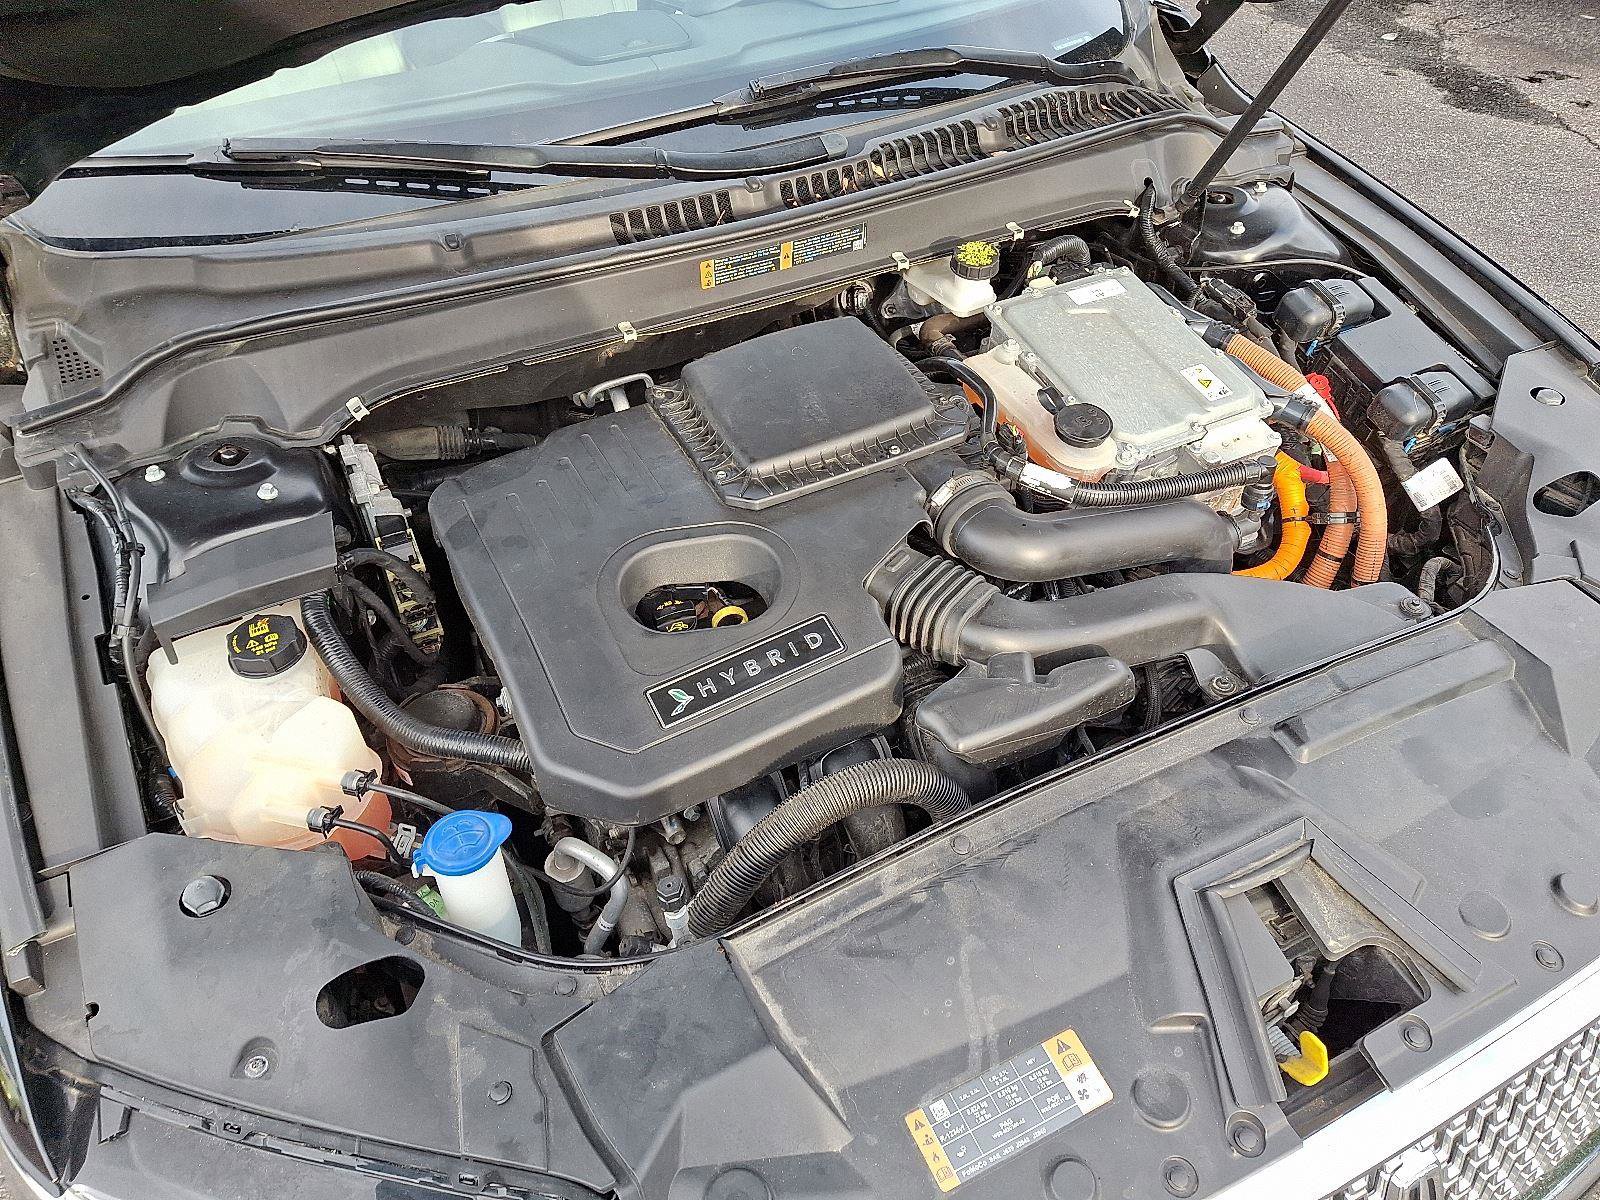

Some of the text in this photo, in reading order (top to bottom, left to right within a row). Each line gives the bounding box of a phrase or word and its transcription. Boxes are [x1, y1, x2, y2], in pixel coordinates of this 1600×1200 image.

[696, 632, 823, 699] HYBRID
[428, 898, 440, 908] DA
[961, 1160, 987, 1177] FoMoCo
